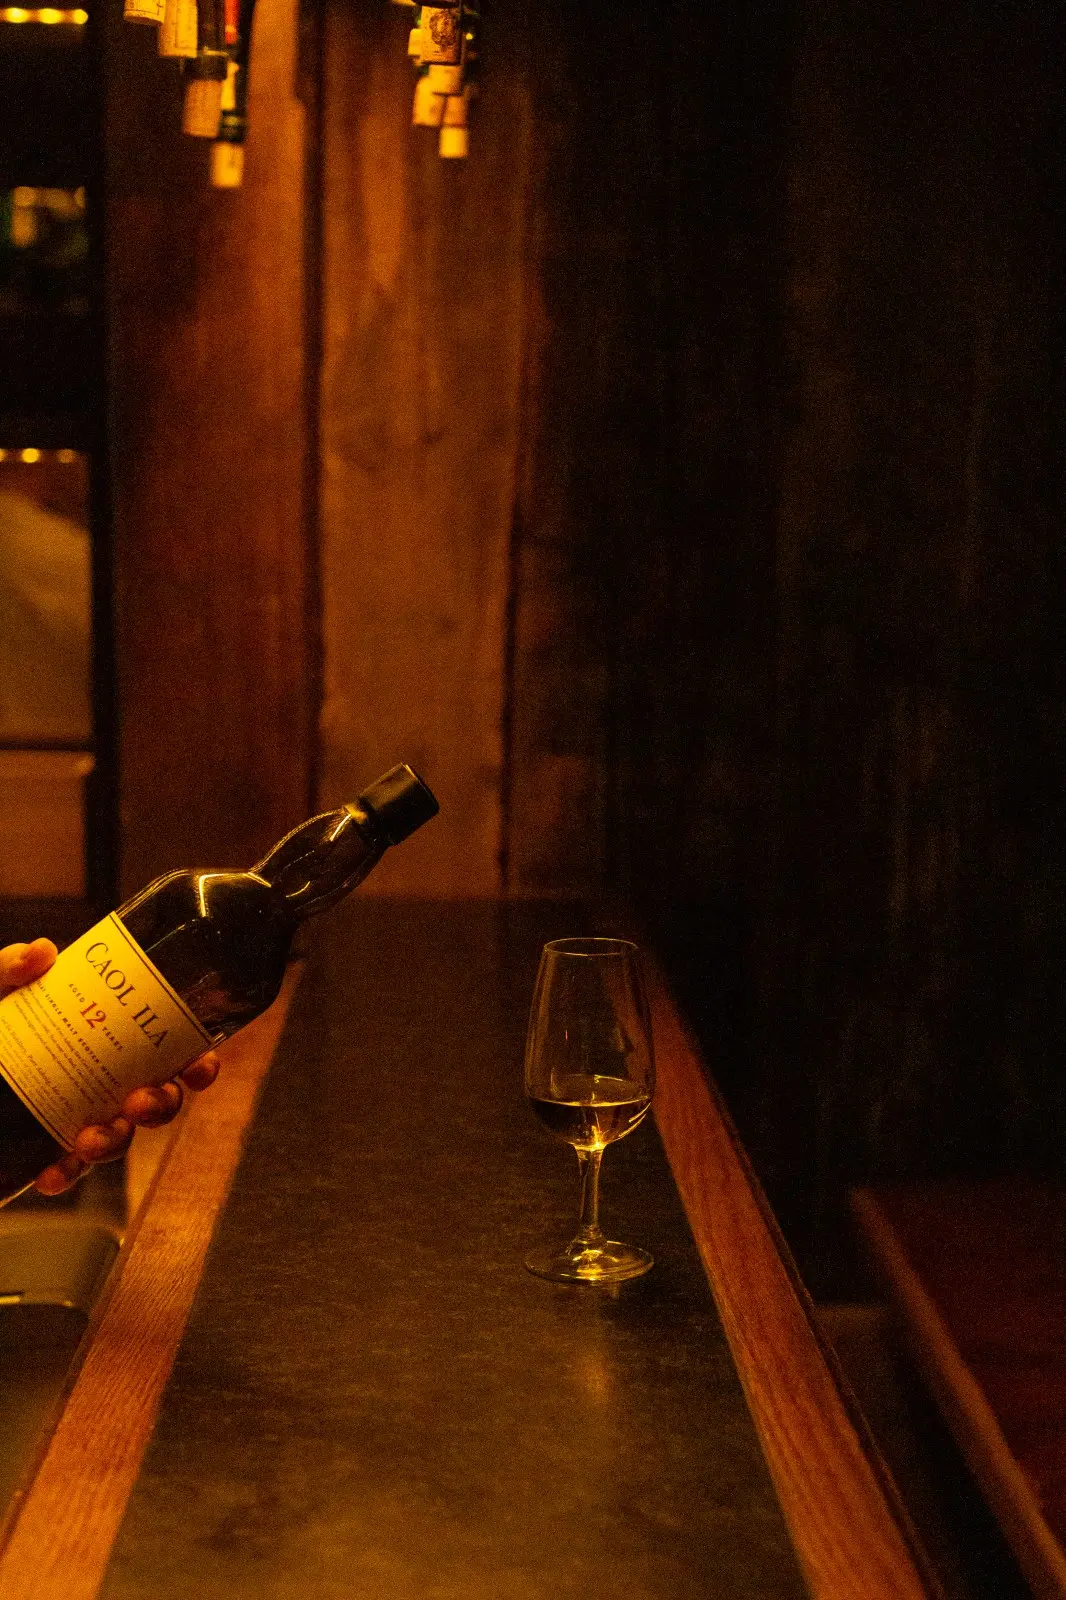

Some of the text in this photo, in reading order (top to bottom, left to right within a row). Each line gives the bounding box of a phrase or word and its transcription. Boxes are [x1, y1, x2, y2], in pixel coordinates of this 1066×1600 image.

[43, 992, 63, 1015] SINGLE
[61, 1016, 78, 1035] MALT
[77, 1037, 100, 1064] SCOTCH
[68, 983, 122, 1051] AGED 12 YEARS
[86, 942, 167, 1047] CAOL ILA
